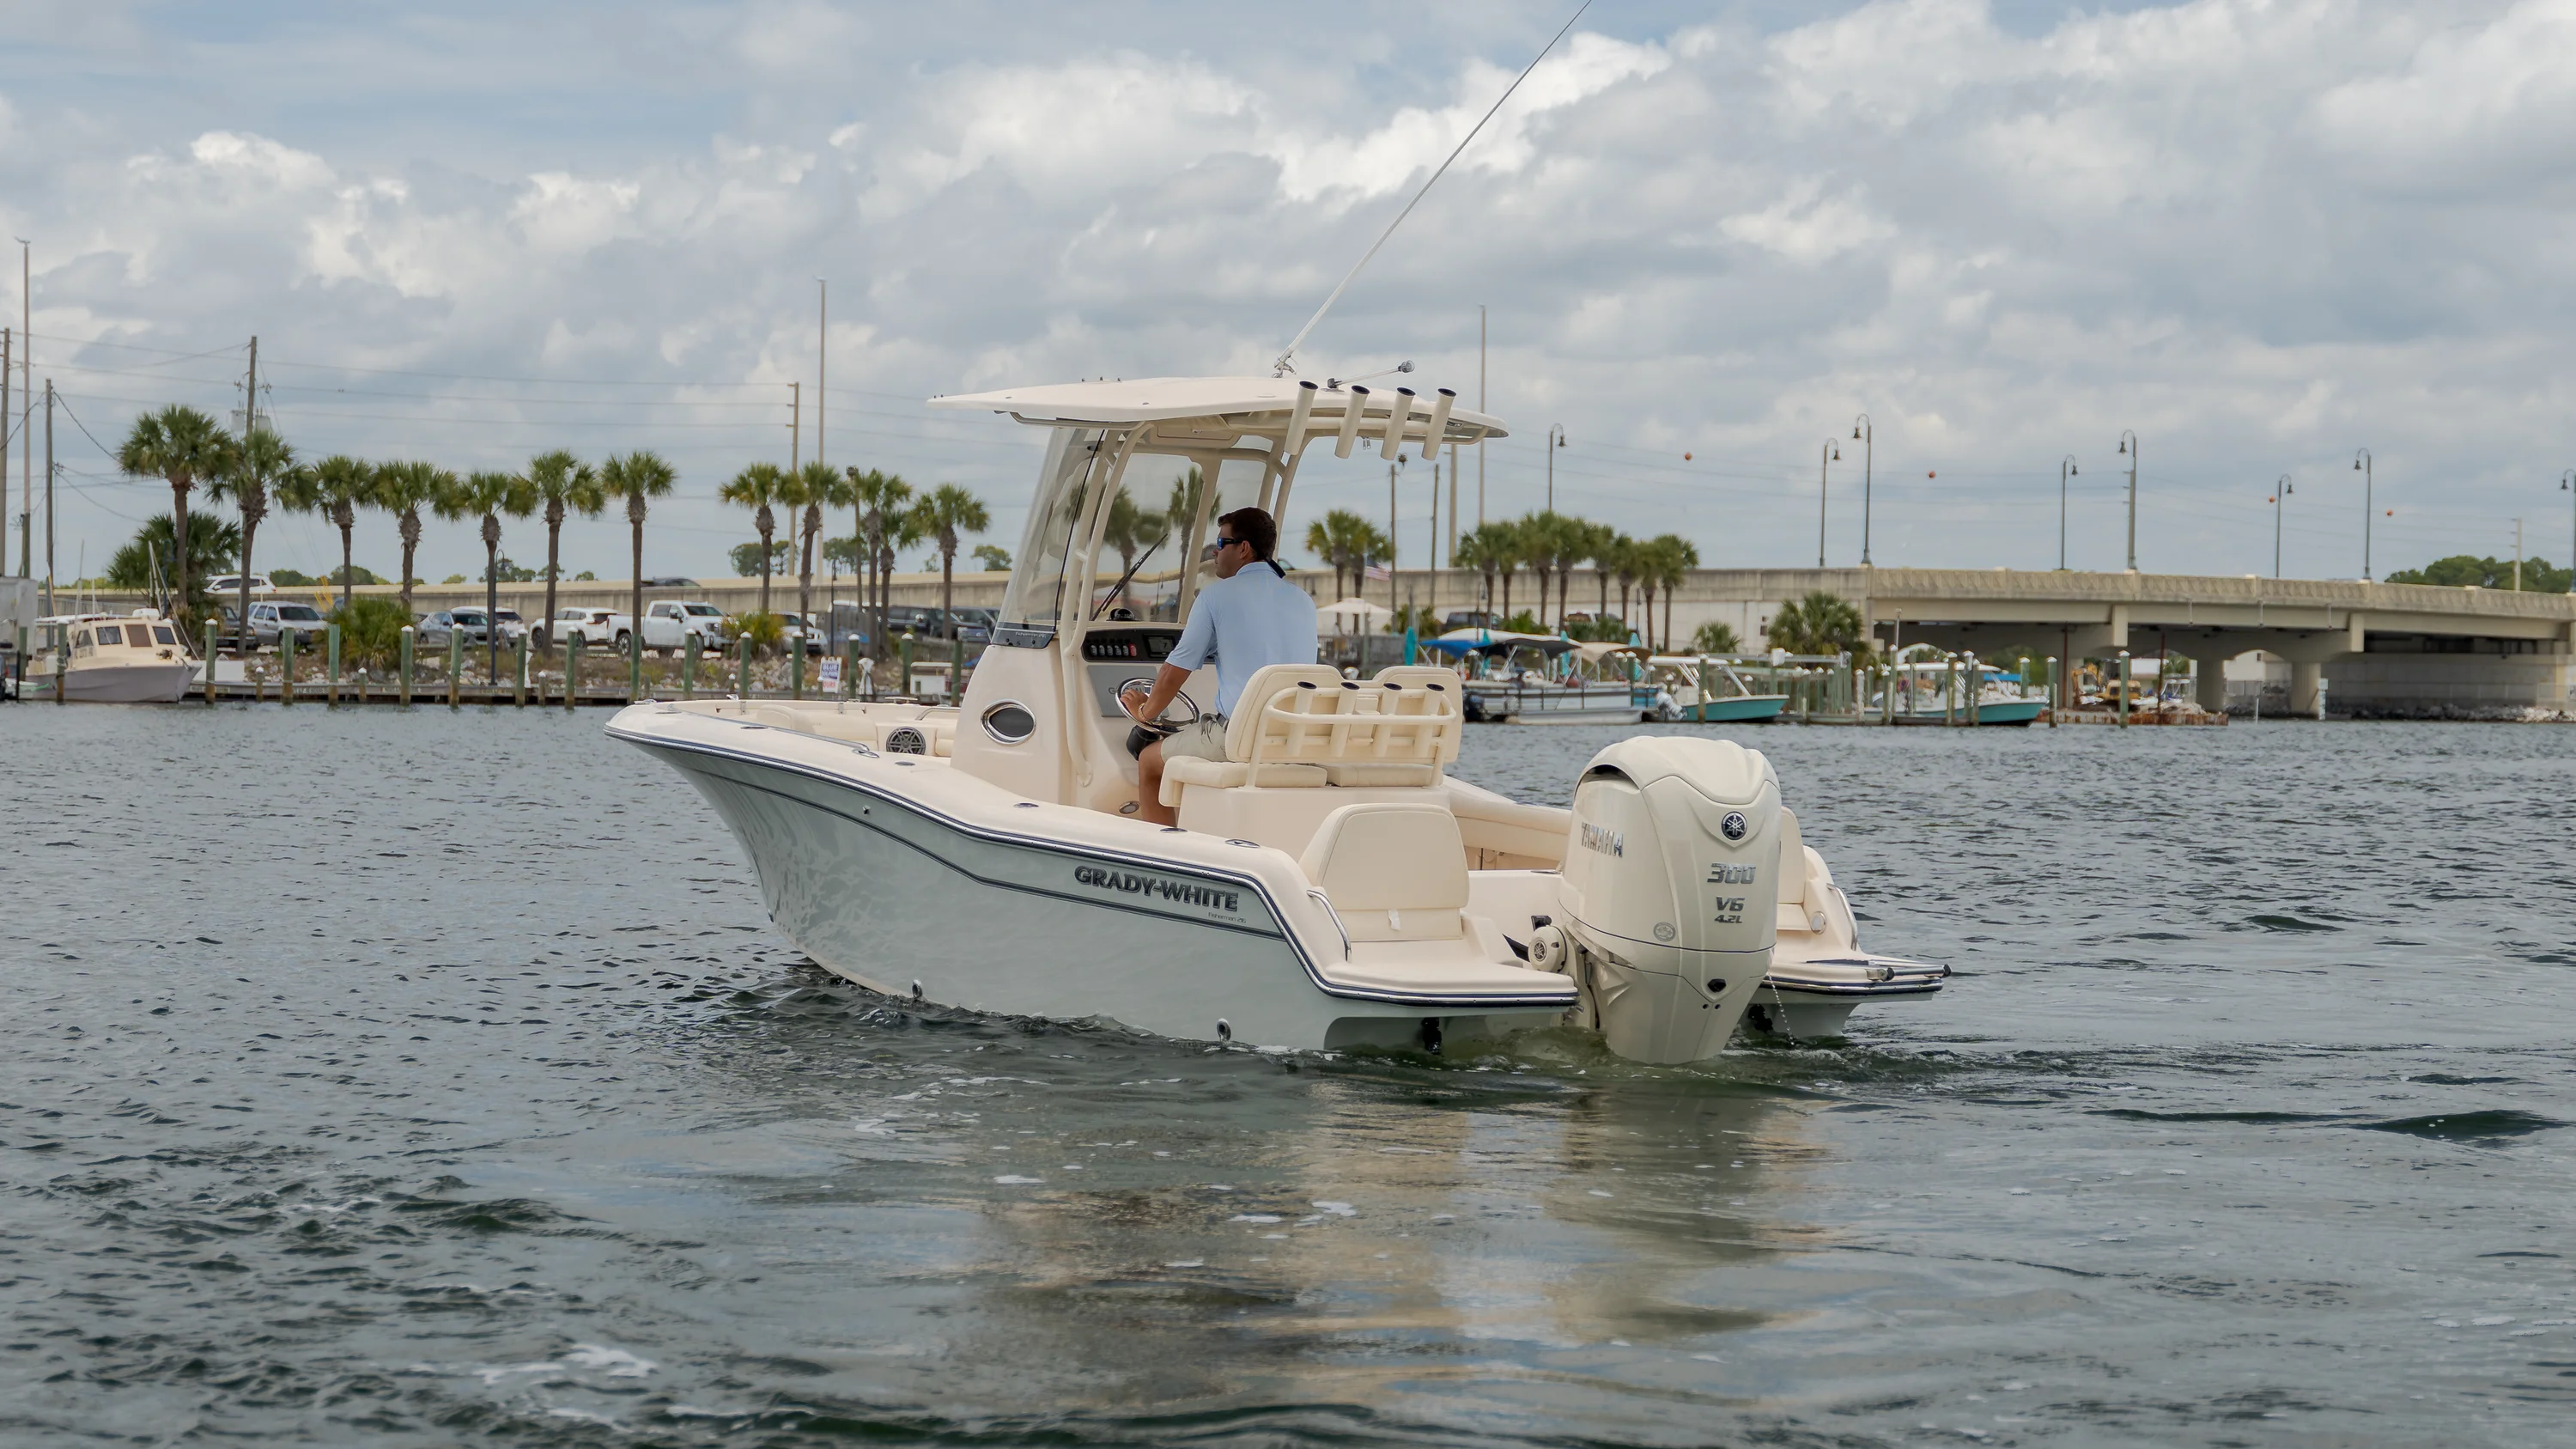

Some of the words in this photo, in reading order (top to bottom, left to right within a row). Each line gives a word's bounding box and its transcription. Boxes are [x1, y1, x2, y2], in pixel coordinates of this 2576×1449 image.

[1707, 862, 1756, 884] 300
[1074, 865, 1238, 912] GRADY-WHITE
[1716, 896, 1745, 911] V6
[1714, 914, 1743, 924] 4.2L
